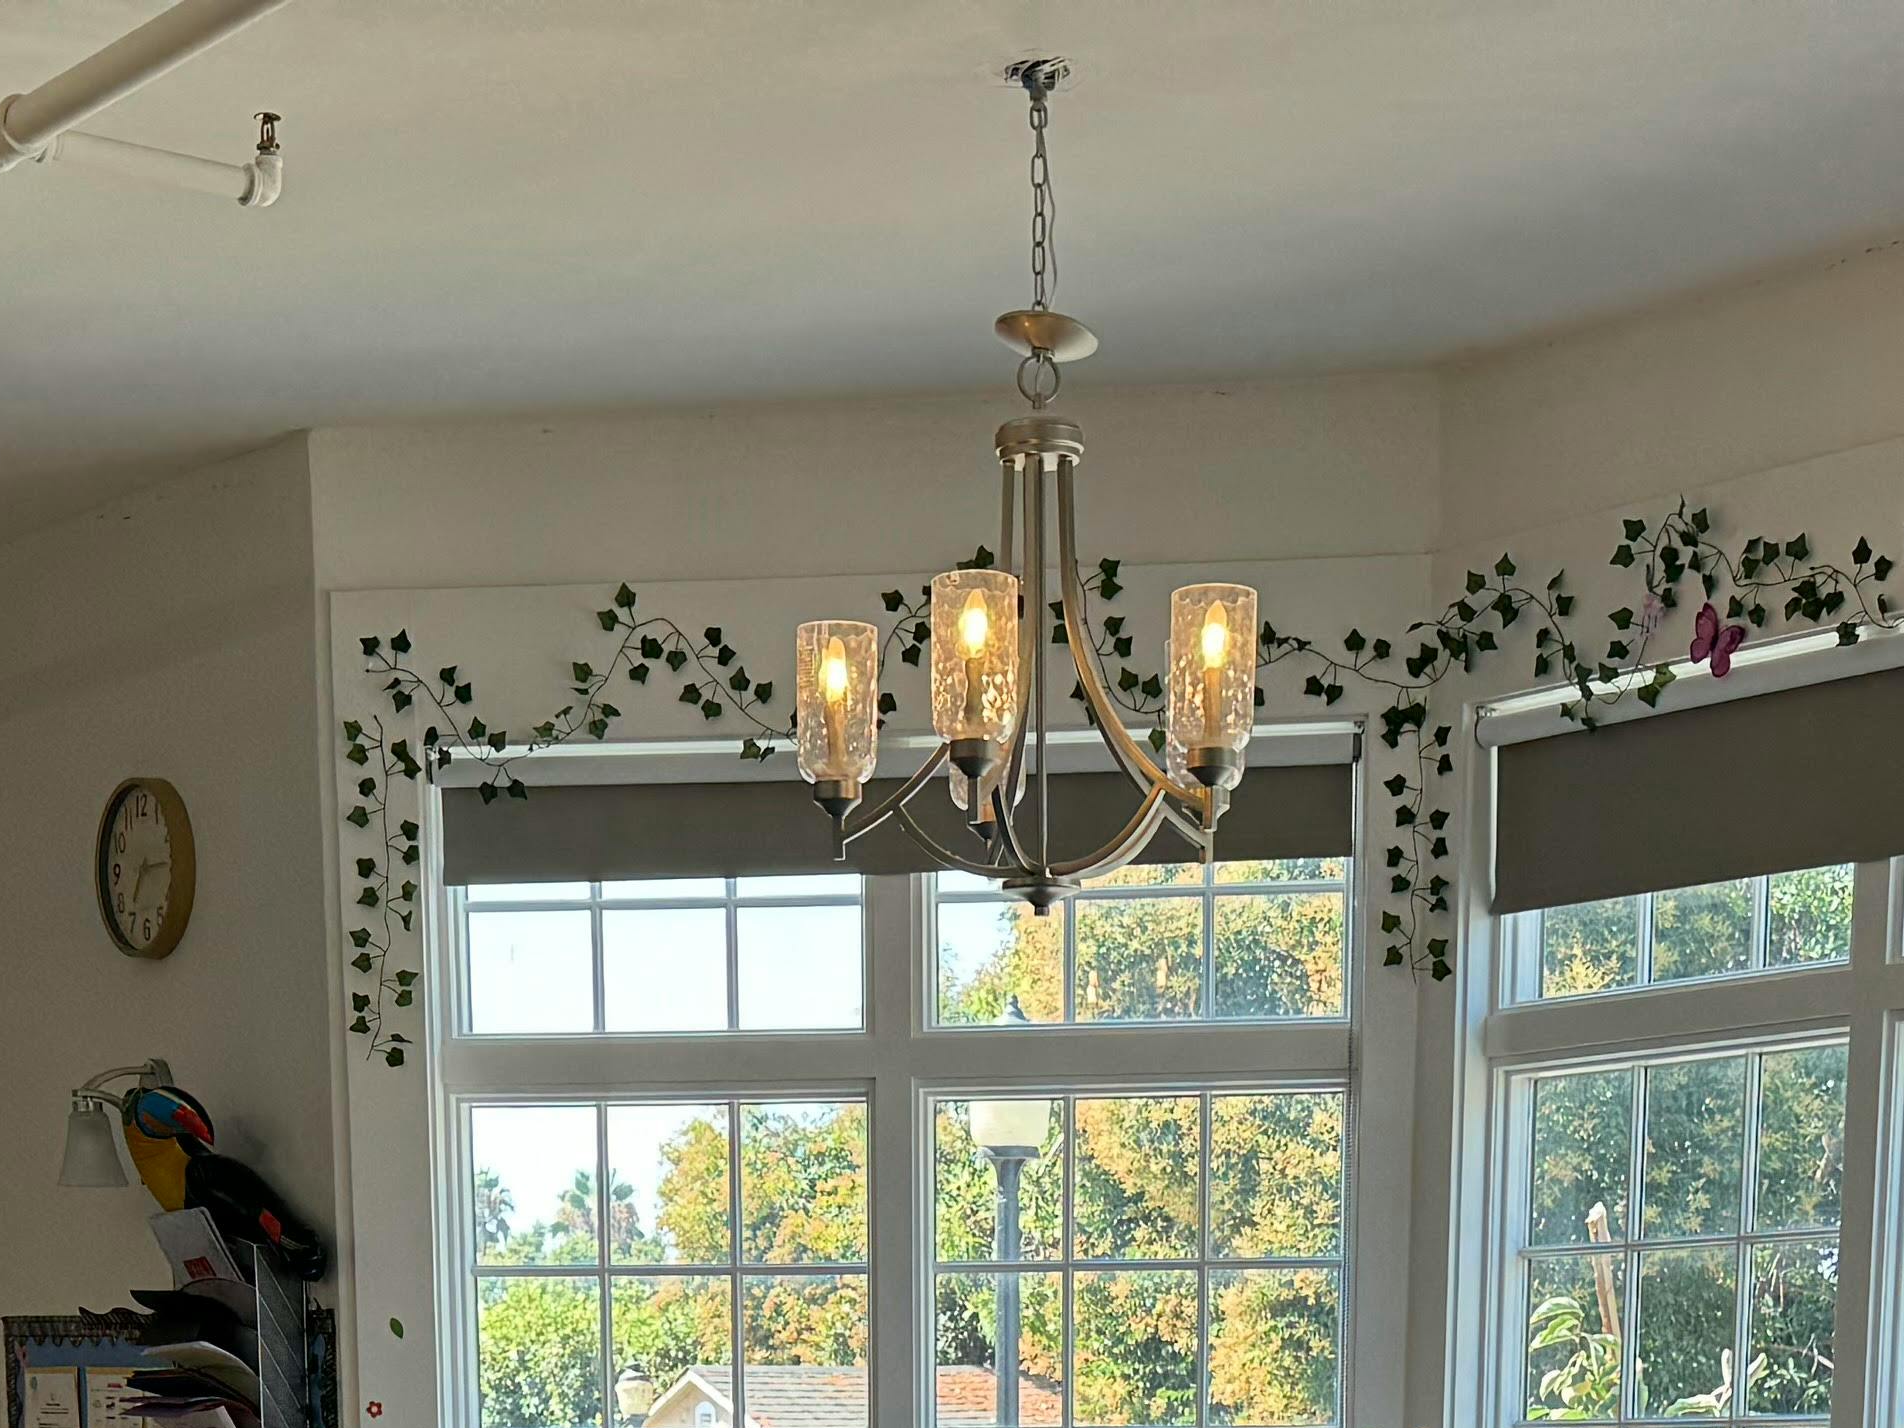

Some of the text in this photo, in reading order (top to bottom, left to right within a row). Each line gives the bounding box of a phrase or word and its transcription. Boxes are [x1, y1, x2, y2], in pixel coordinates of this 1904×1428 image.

[136, 794, 147, 818] 12
[113, 863, 121, 885] 9
[143, 918, 150, 941] 6
